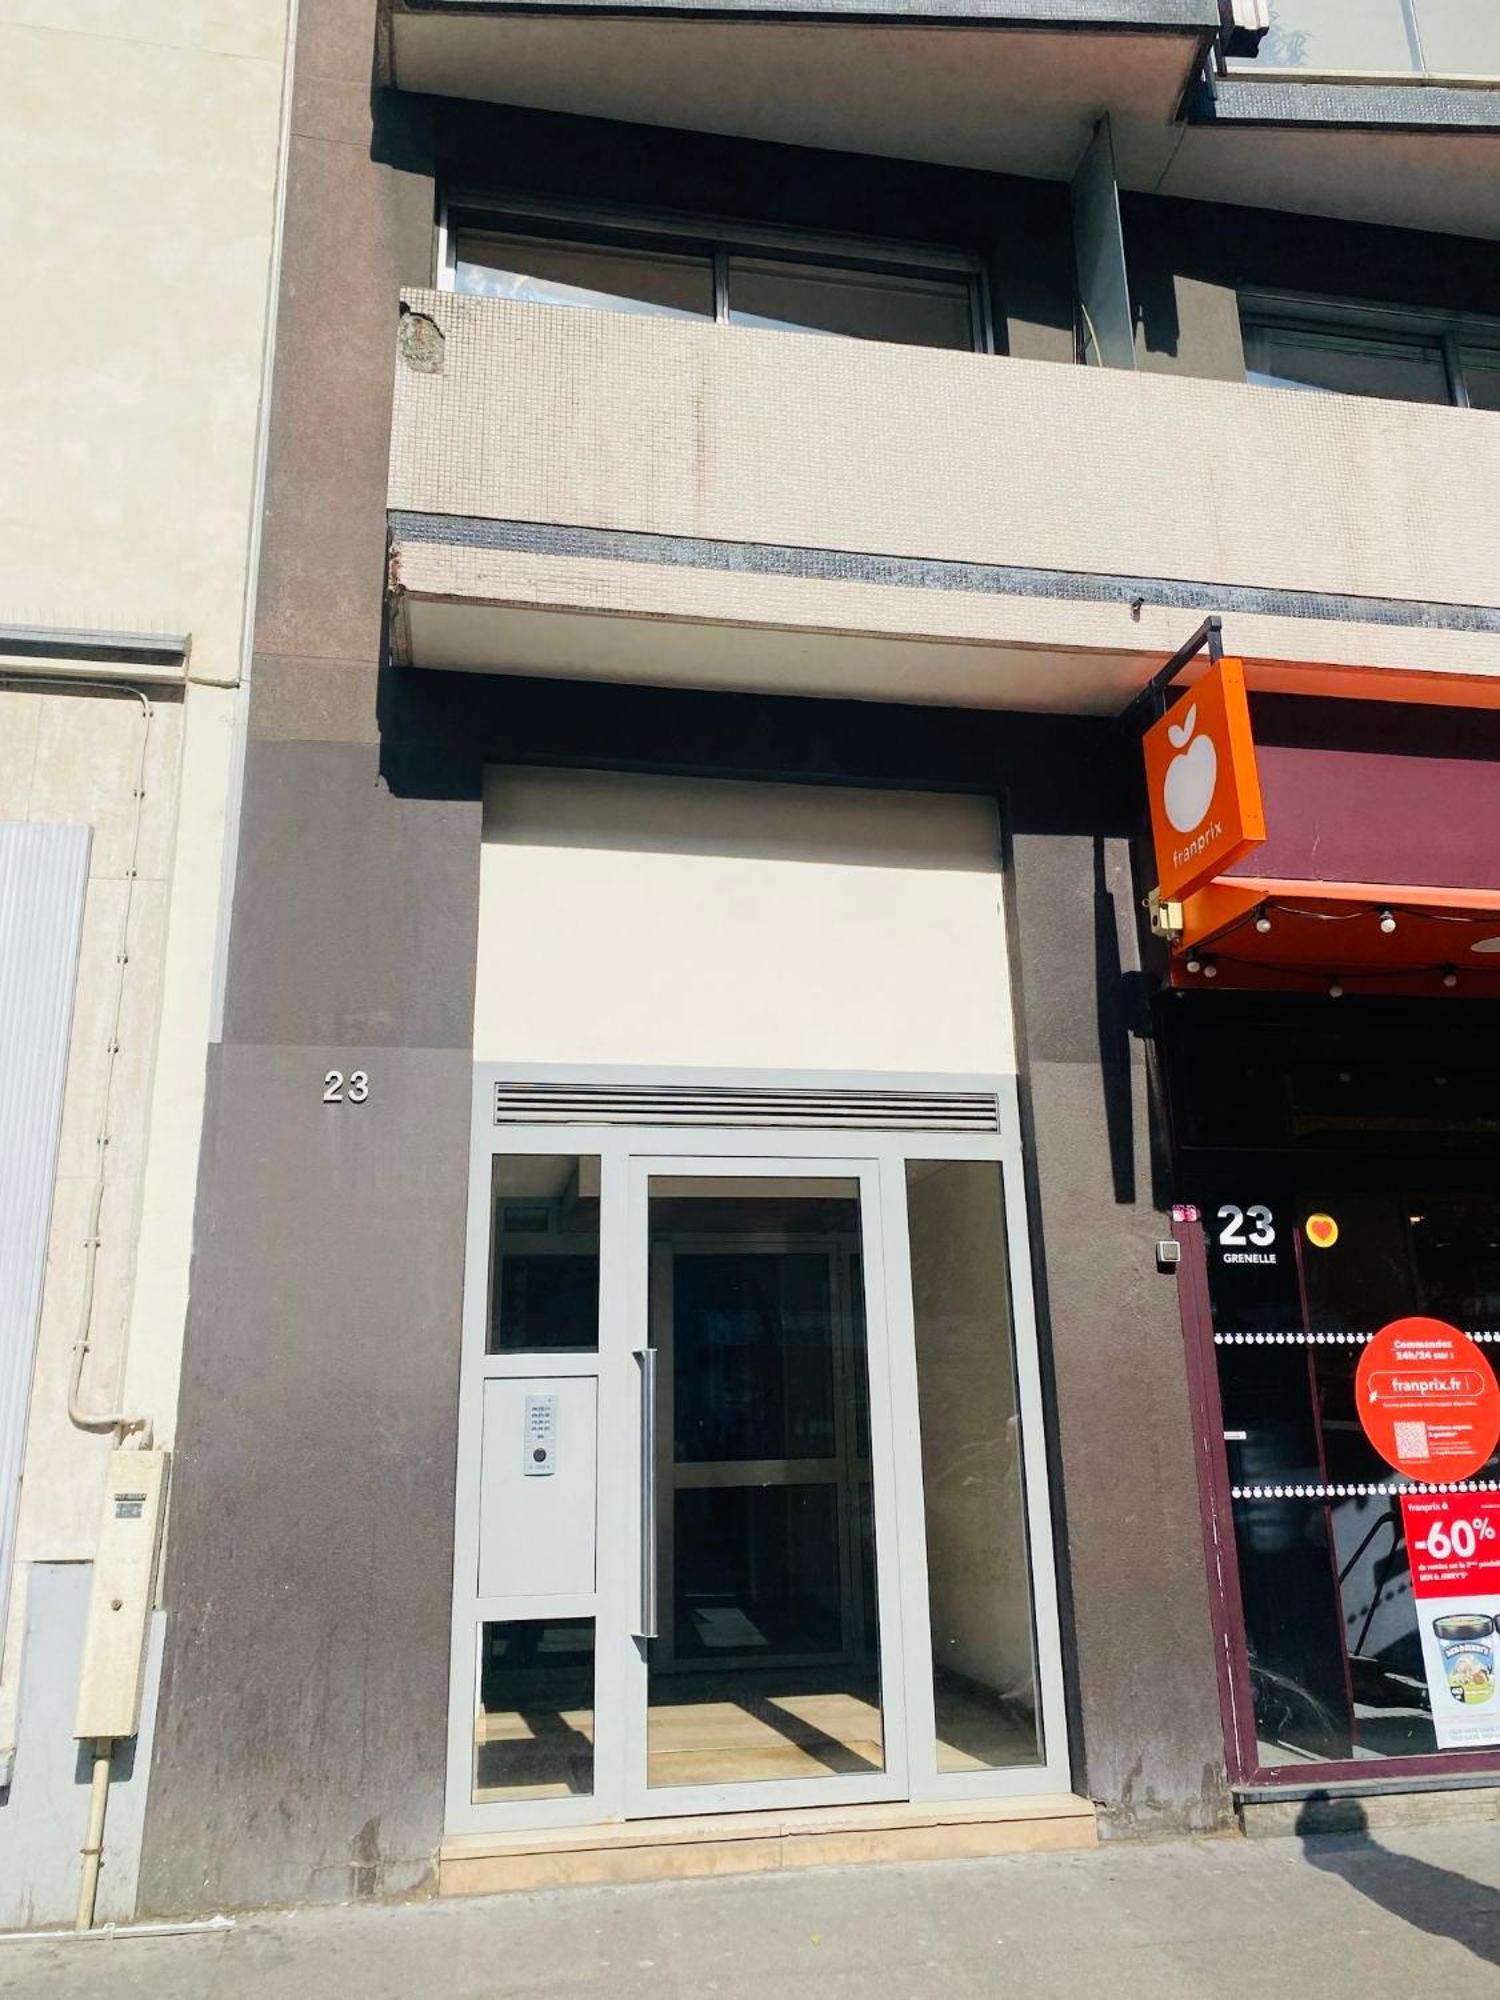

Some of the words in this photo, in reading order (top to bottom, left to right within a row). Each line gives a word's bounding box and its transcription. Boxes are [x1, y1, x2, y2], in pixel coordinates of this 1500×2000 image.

[1172, 820, 1224, 870] franprix
[323, 1070, 369, 1103] 23
[1216, 1204, 1276, 1247] 23
[1223, 1252, 1277, 1265] GRENELLE
[1391, 1377, 1462, 1395] franprix.fr
[1407, 1502, 1441, 1513] franprix
[1414, 1517, 1496, 1560] -60%
